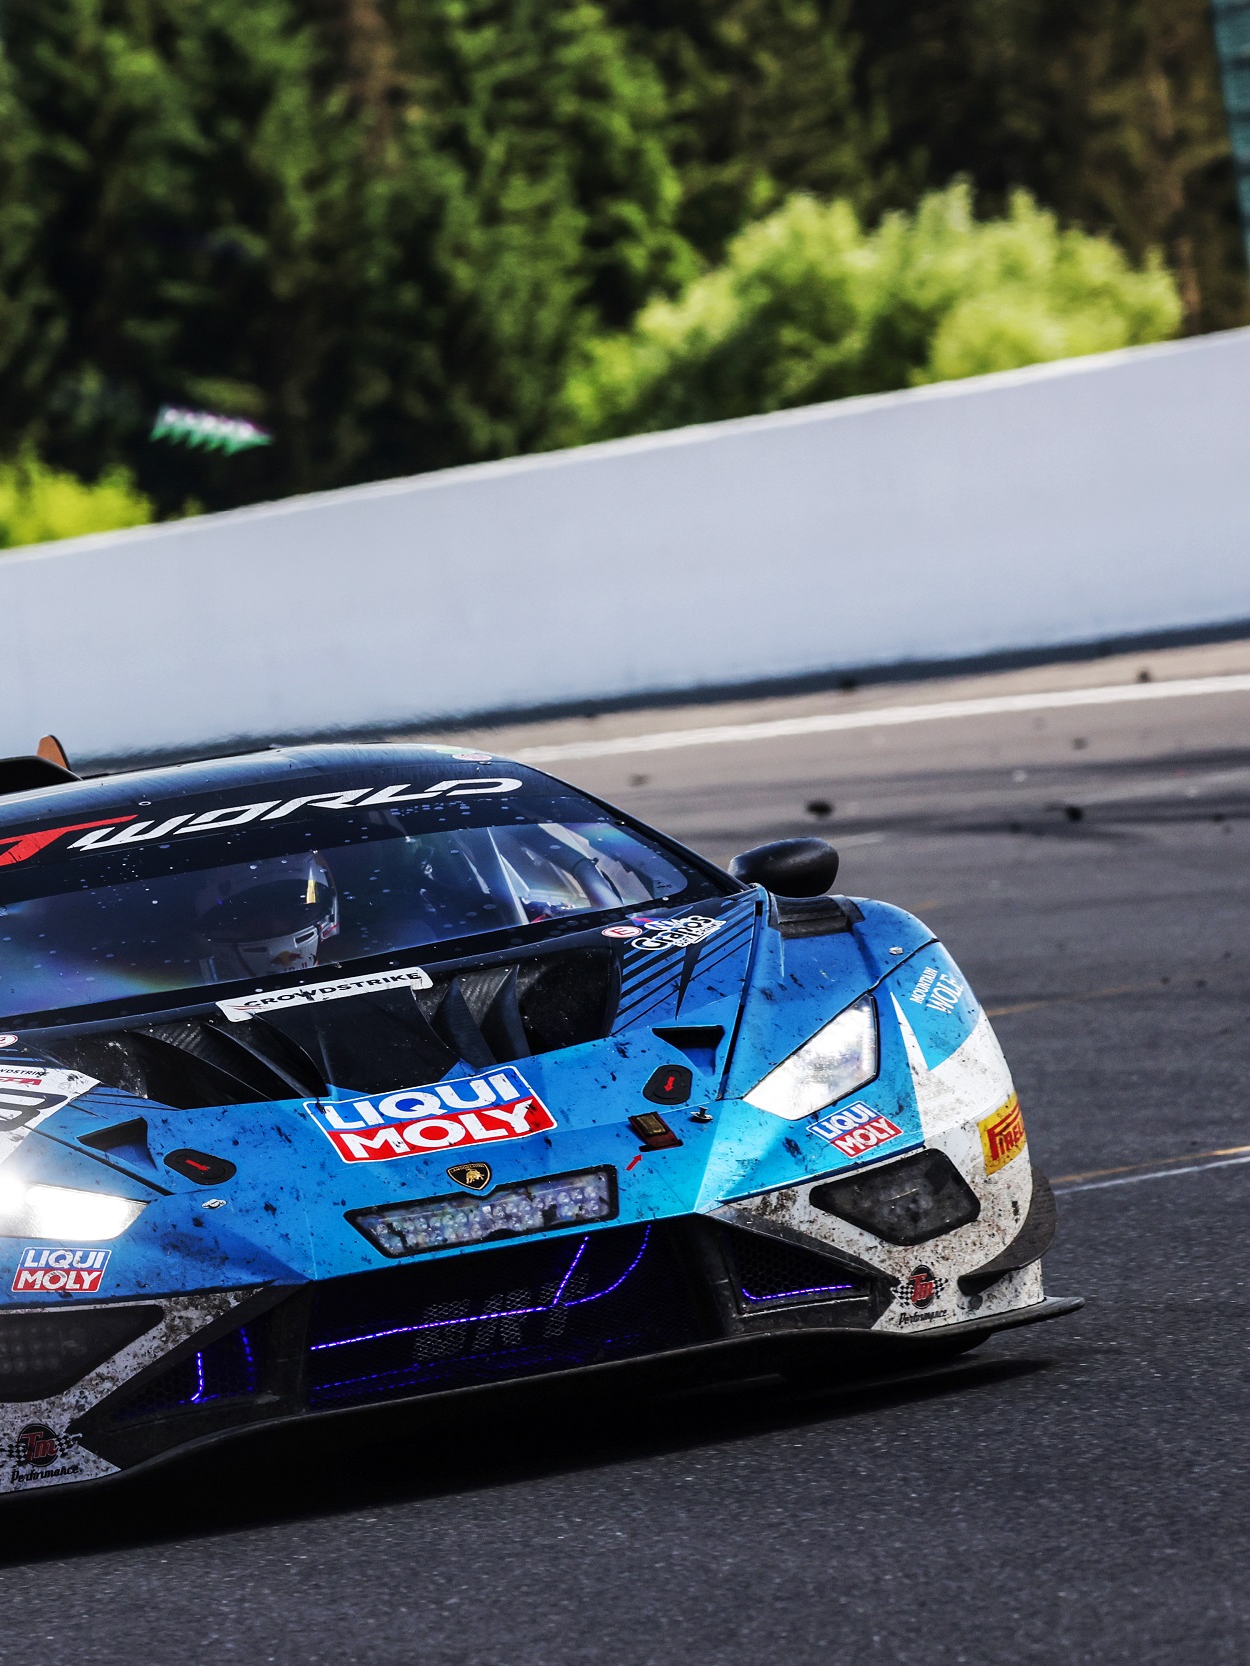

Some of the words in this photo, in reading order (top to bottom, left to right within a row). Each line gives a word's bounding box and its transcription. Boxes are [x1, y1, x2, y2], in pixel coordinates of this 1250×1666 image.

[66, 778, 523, 851] WORLD
[244, 972, 422, 1006] CROWDSTRIKE
[909, 966, 938, 1004] MOUNTAIN
[325, 1073, 521, 1129] LIQUI
[340, 1099, 533, 1158] MOLY
[812, 1103, 877, 1139] LIQUI
[835, 1117, 896, 1155] MOLY
[987, 1103, 1024, 1161] PIREL
[24, 1250, 105, 1269] LIQUI
[17, 1270, 101, 1290] MOLY
[10, 1465, 79, 1484] Performance
